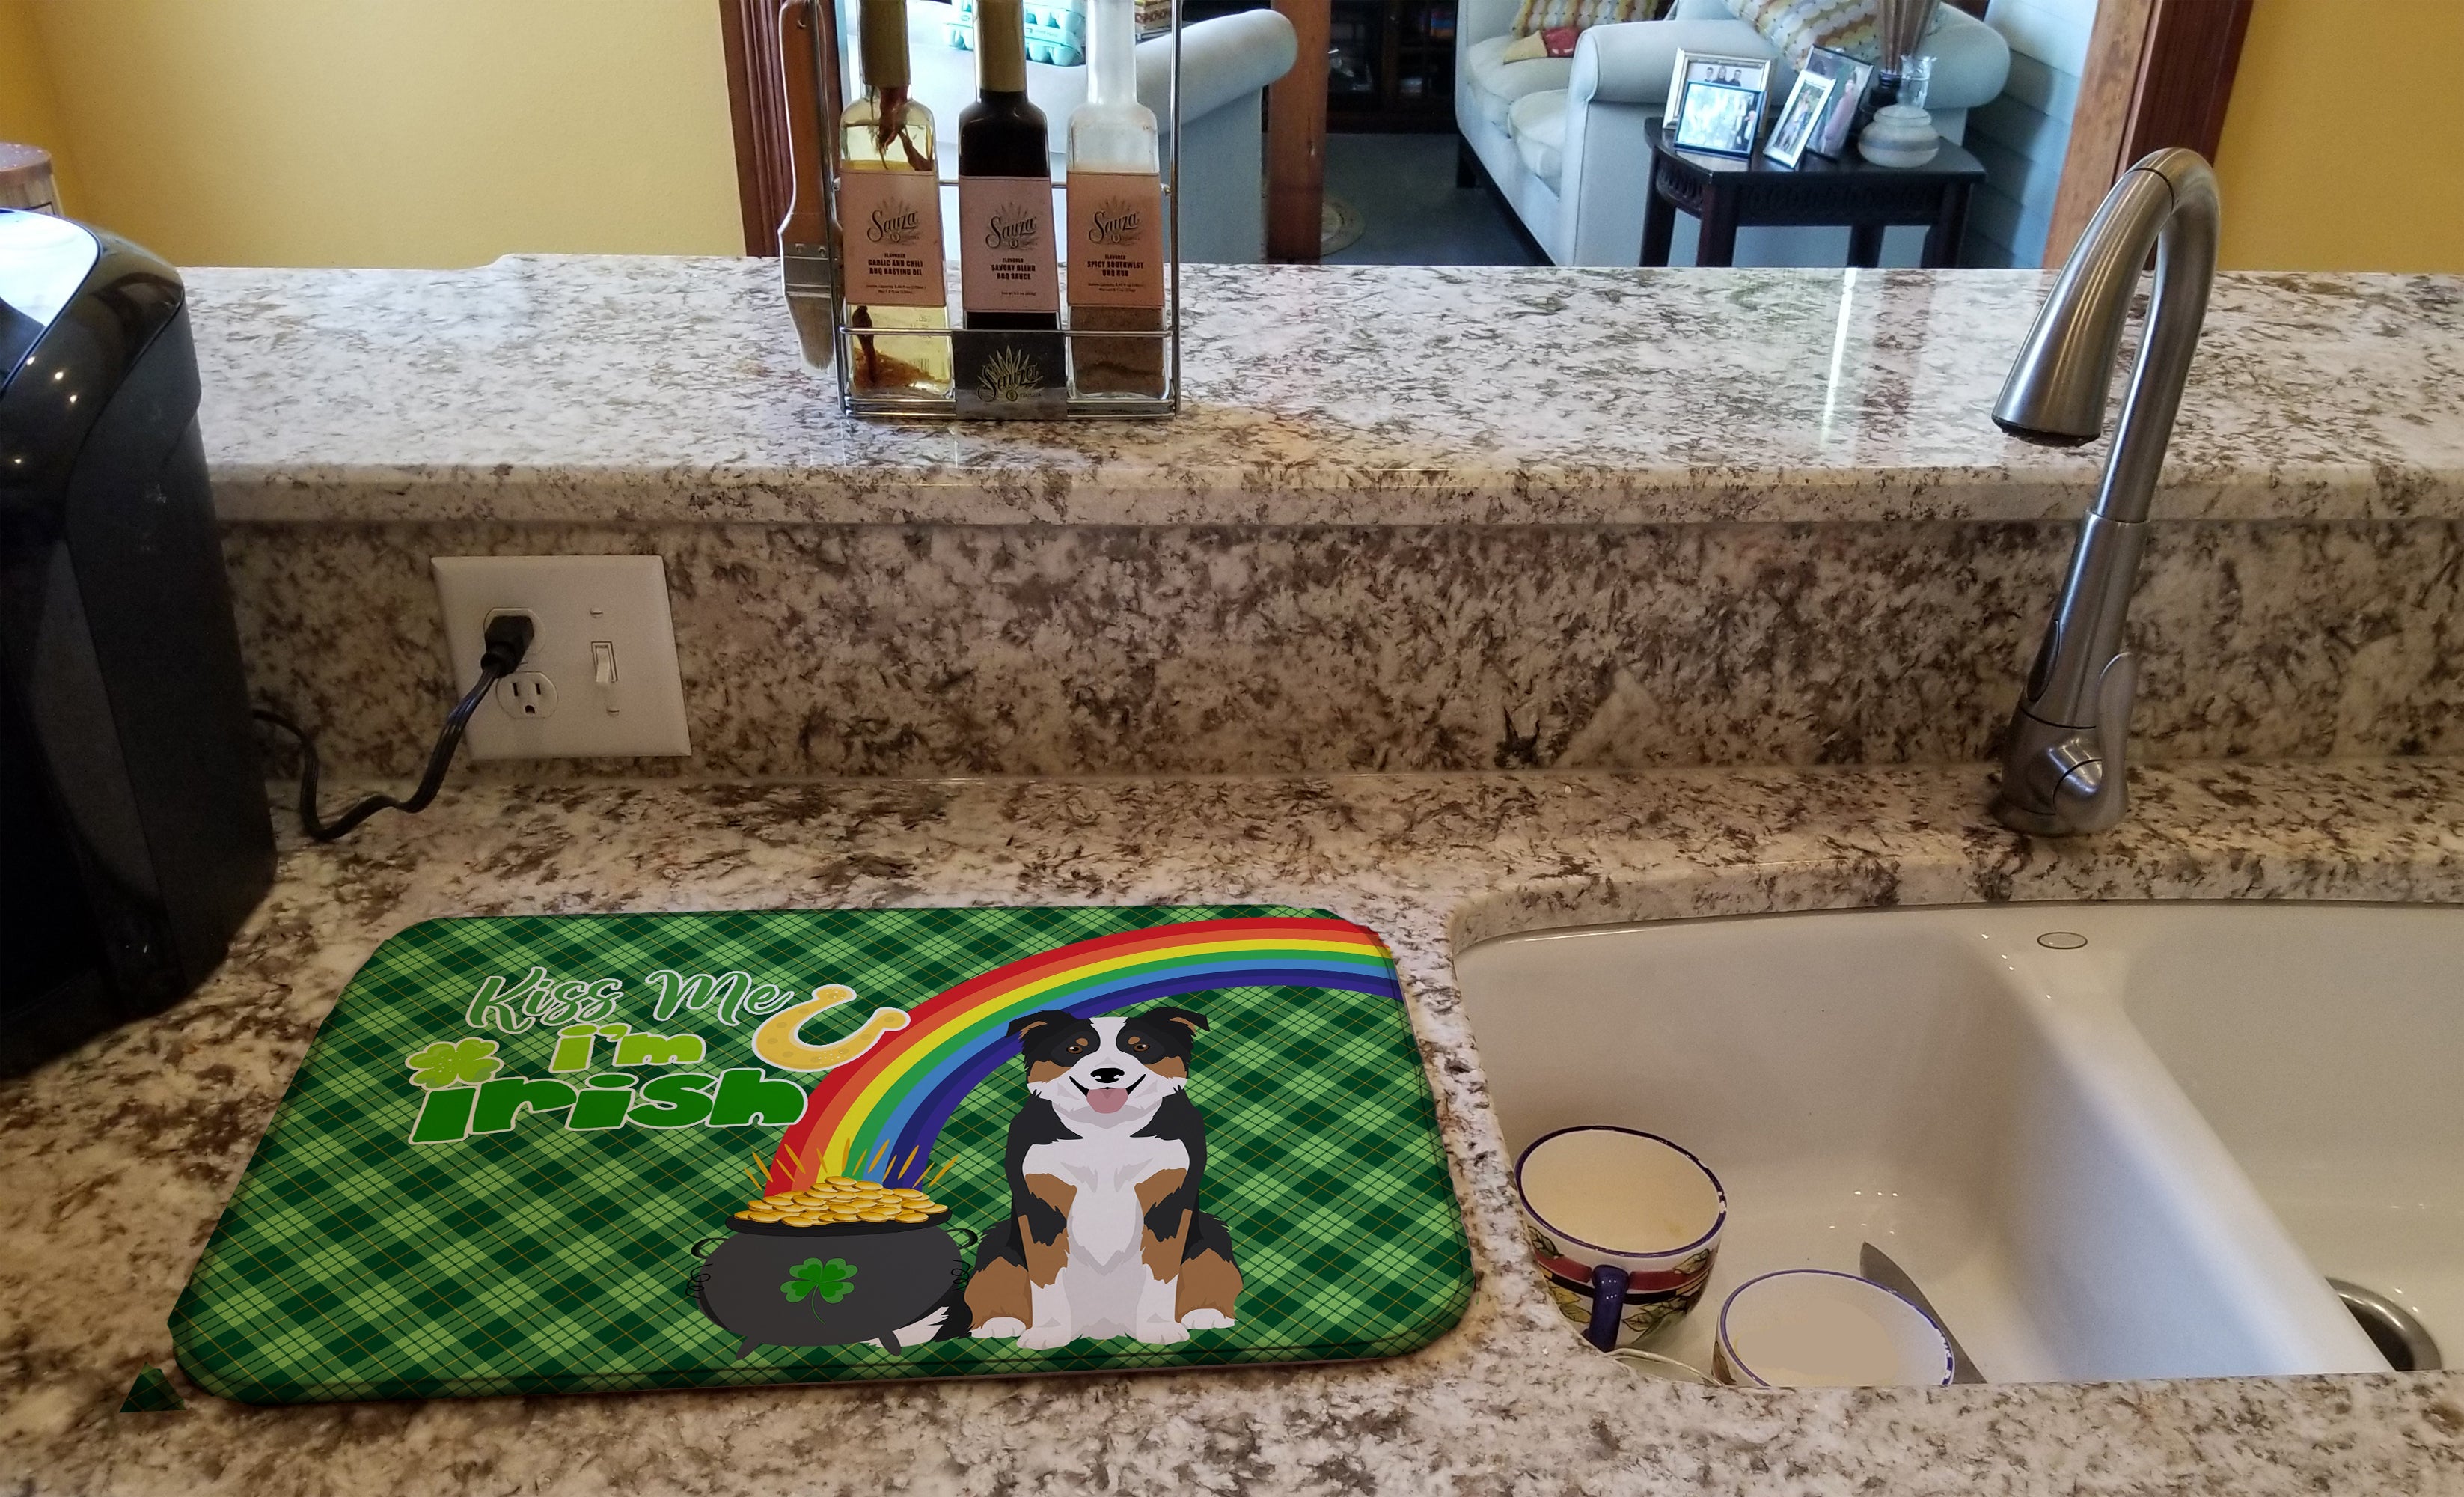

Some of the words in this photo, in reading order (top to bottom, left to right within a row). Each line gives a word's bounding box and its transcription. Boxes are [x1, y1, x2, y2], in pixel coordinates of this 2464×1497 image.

[866, 210, 918, 243] Sauza
[985, 216, 1037, 249] Sauza
[1088, 210, 1140, 243] Sauza
[977, 364, 1039, 402] Sauza
[465, 966, 624, 1034] Kiss
[646, 969, 794, 1027] Me
